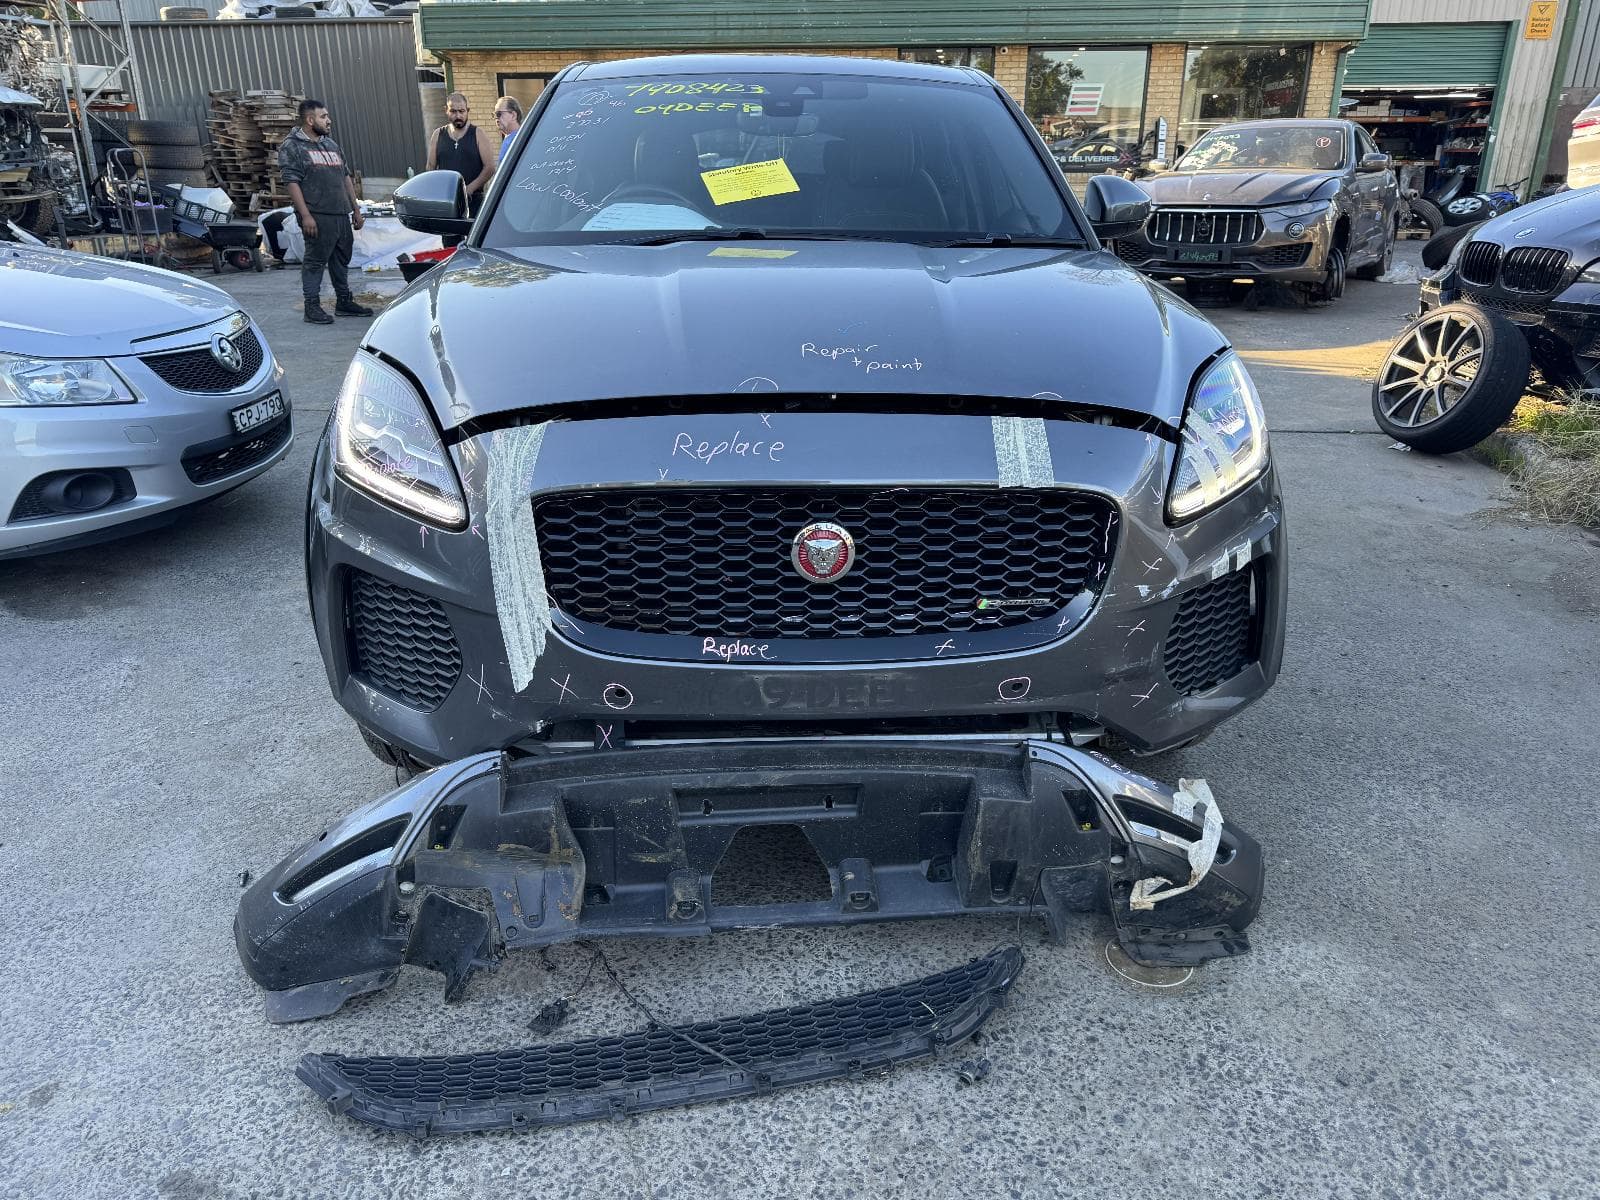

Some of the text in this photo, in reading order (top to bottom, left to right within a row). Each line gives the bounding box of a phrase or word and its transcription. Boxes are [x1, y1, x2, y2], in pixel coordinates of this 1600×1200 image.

[1068, 155, 1118, 163] DELIVERIES
[801, 342, 878, 360] Repair
[866, 358, 922, 373] paint
[673, 430, 785, 464] Replace
[703, 636, 777, 662] Replace
